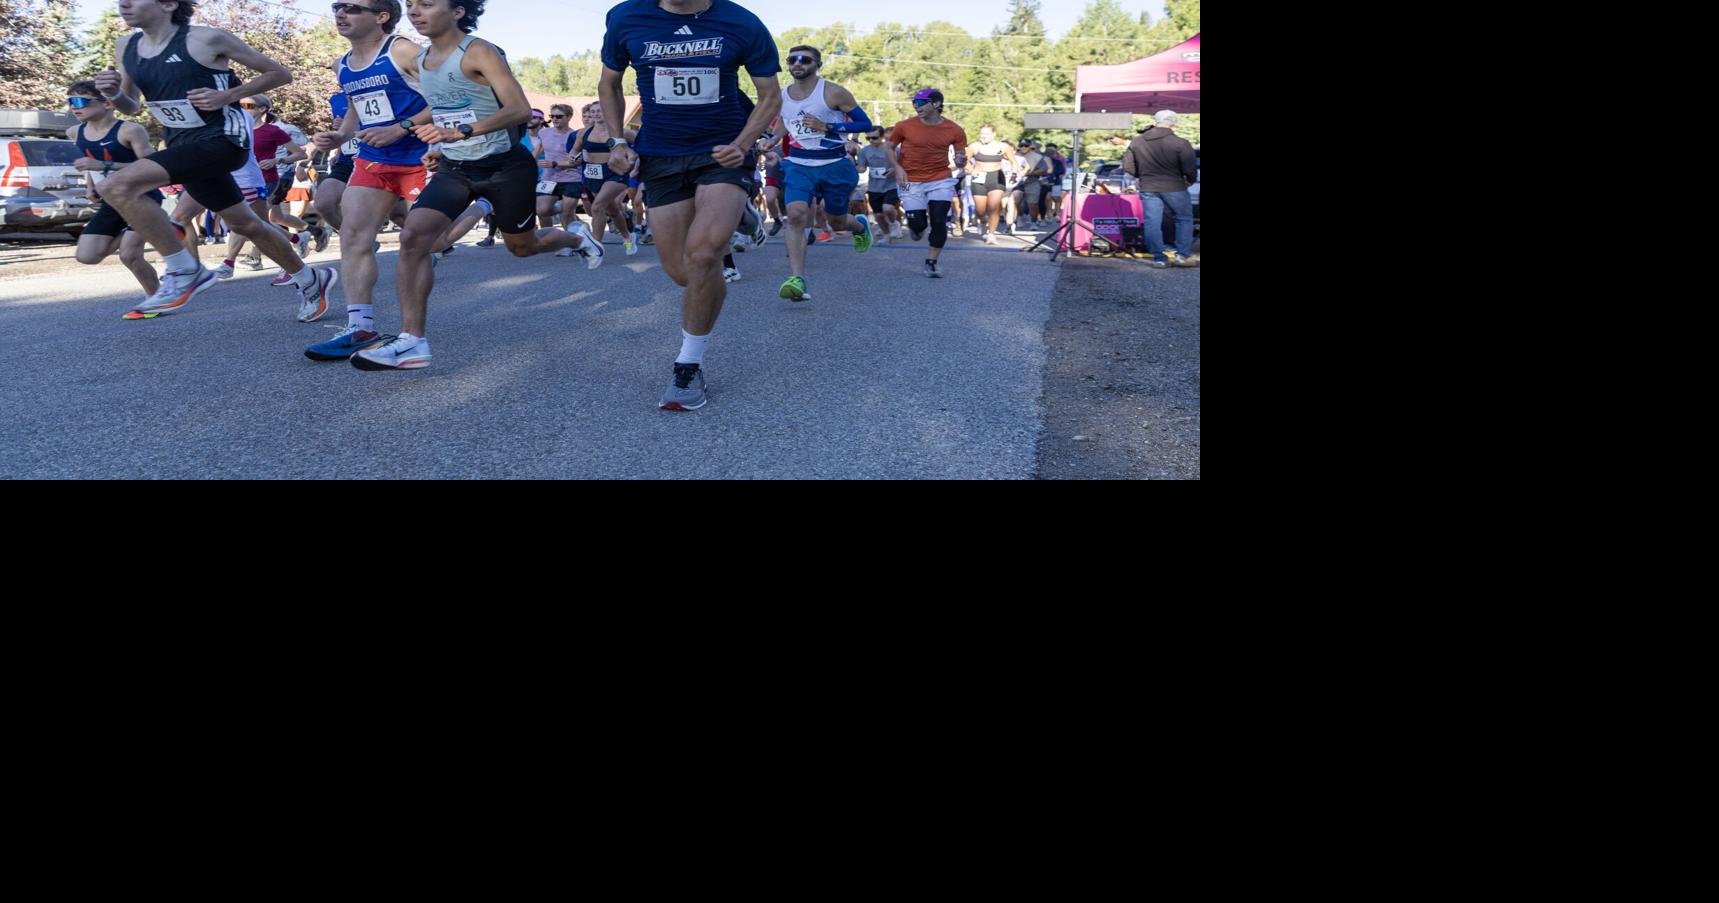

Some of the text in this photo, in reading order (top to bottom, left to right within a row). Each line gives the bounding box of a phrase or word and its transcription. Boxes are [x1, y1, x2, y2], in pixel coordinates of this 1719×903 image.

[647, 39, 720, 56] BUCKNELL
[673, 76, 701, 96] 50
[161, 107, 186, 122] 93
[364, 99, 380, 117] 43
